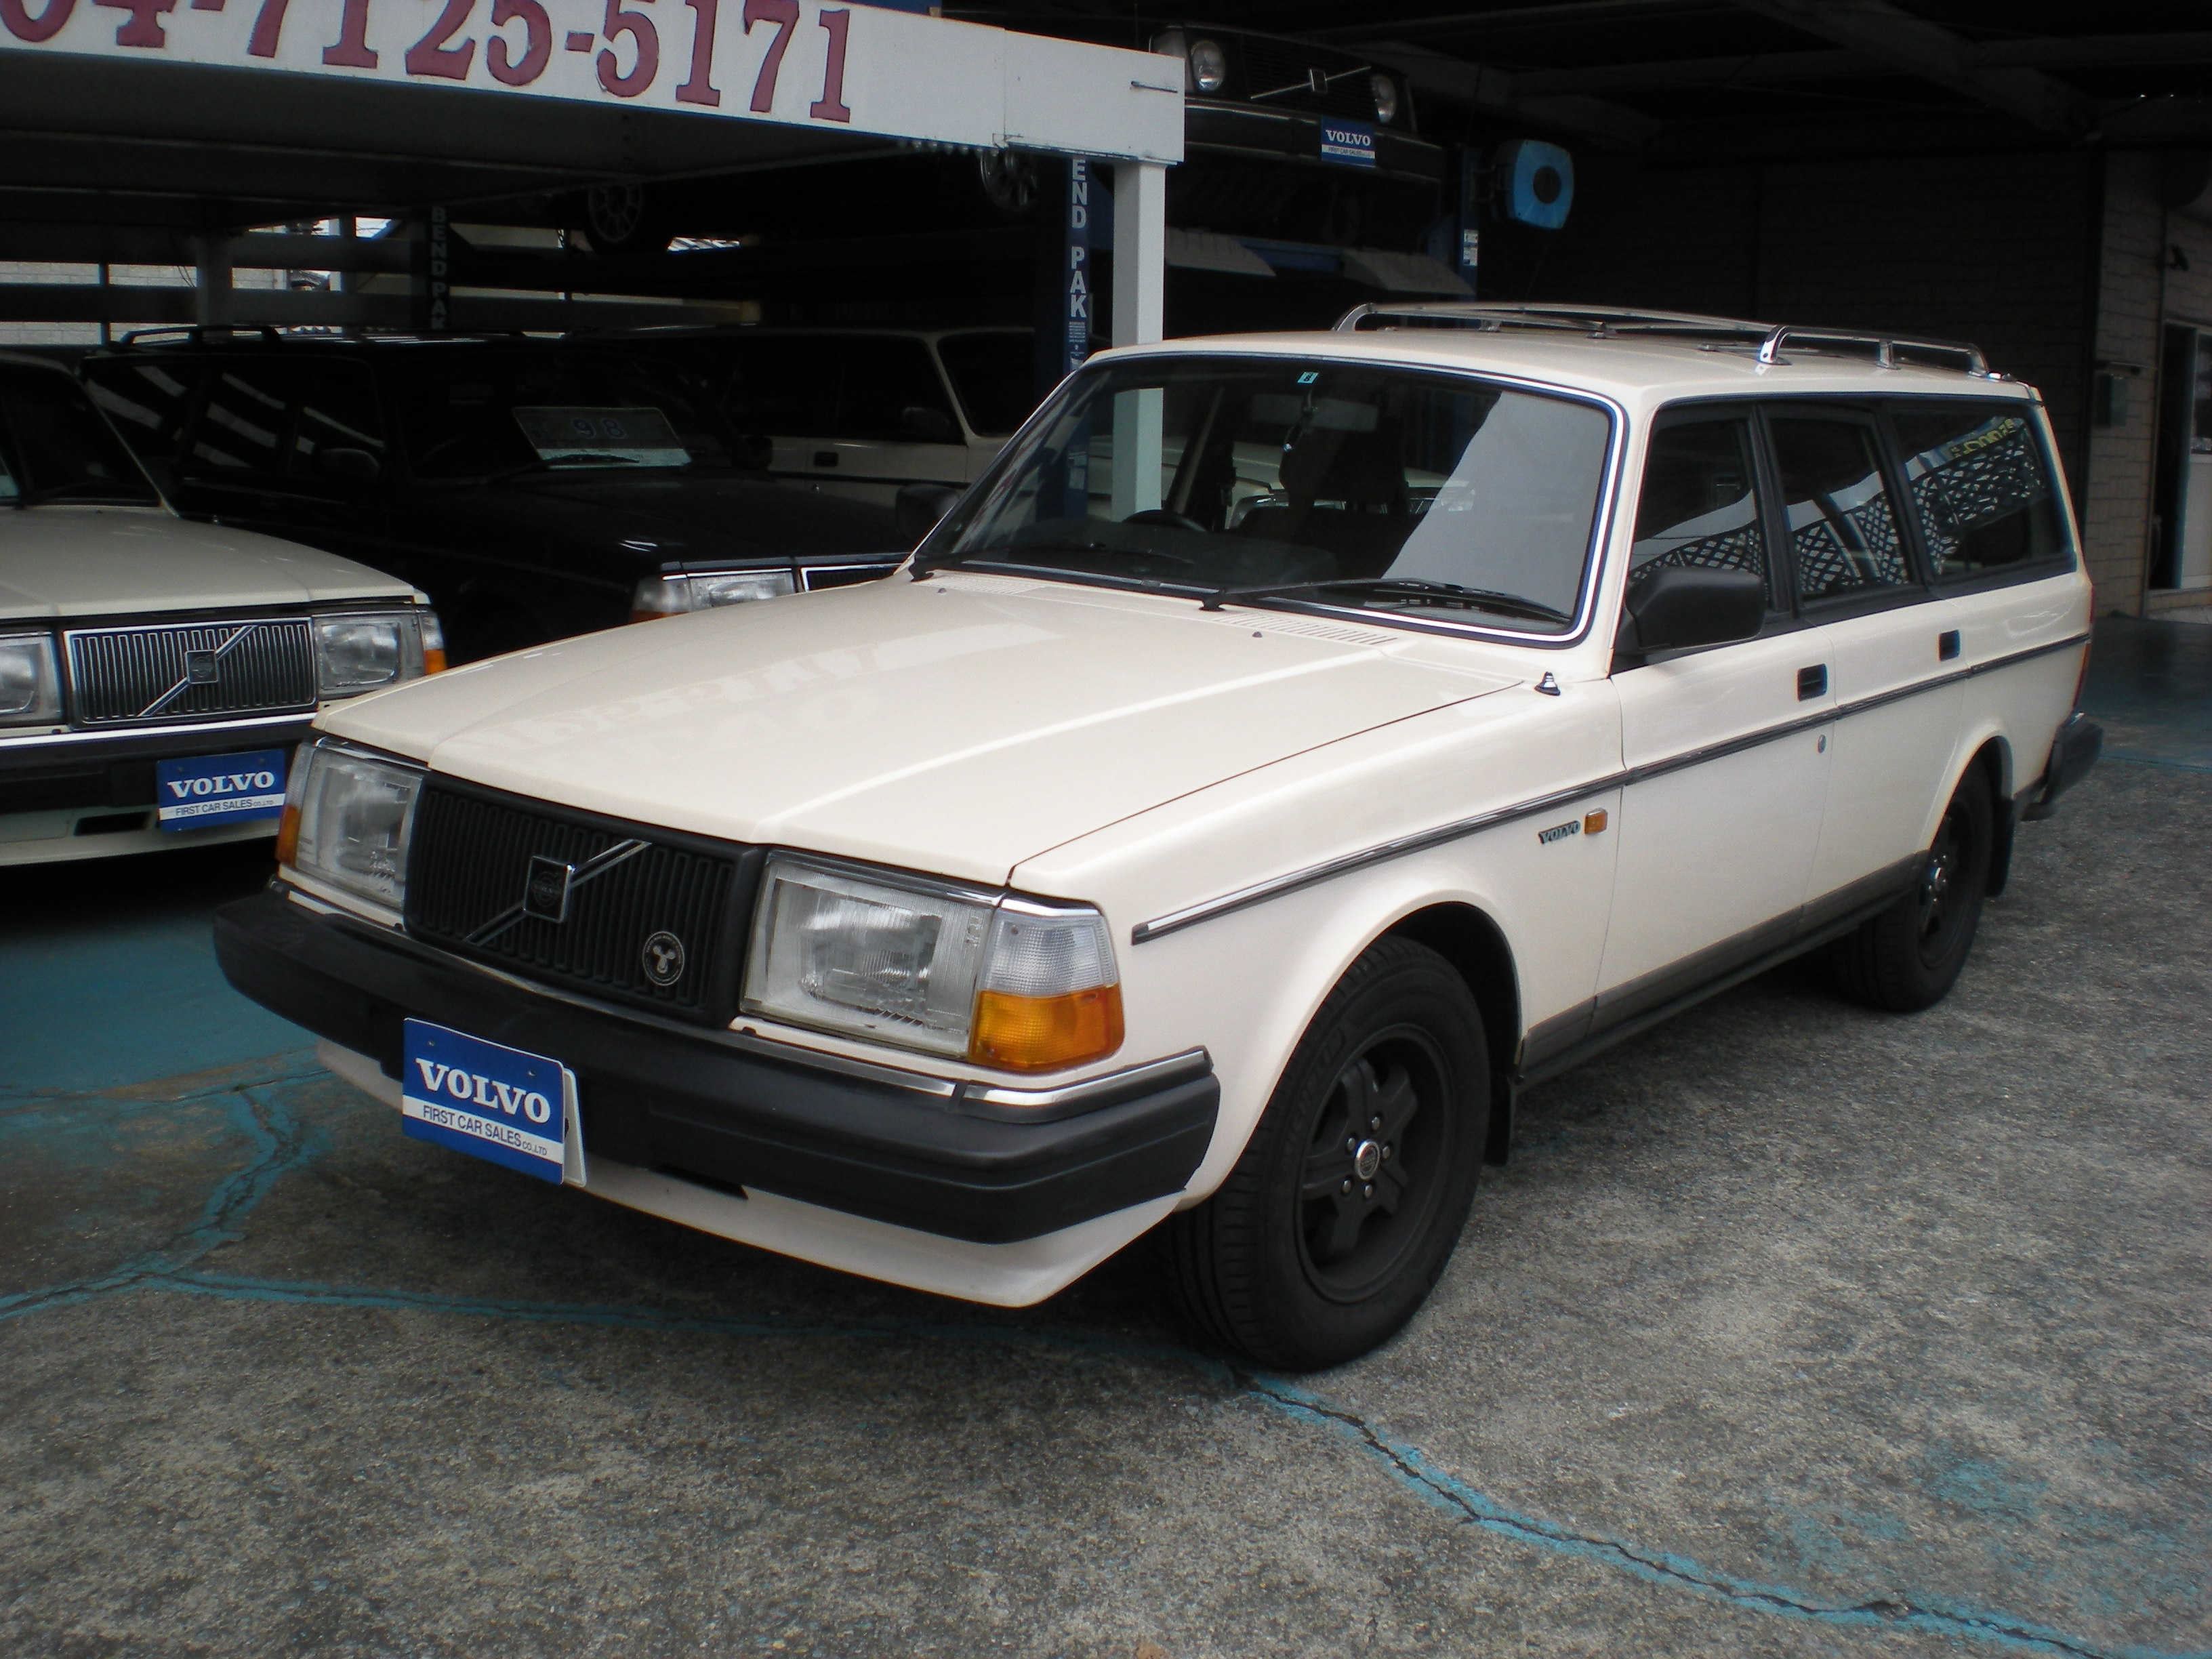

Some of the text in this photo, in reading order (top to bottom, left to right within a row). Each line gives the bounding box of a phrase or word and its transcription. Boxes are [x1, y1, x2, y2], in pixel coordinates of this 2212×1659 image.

[0, 0, 851, 123] -25-5171
[1326, 129, 1371, 146] VOLVO
[430, 206, 447, 329] BEND PAK
[1069, 246, 1087, 318] PAK
[167, 771, 275, 799] VOLVO
[176, 805, 200, 817] FIRST
[202, 803, 220, 813] CAR
[223, 799, 253, 811] SALES
[1538, 820, 1581, 844] VOLVO
[415, 1057, 551, 1124] VOLVO
[423, 1104, 455, 1126] FIRST
[457, 1115, 483, 1134] CAR
[485, 1123, 522, 1147] SALES
